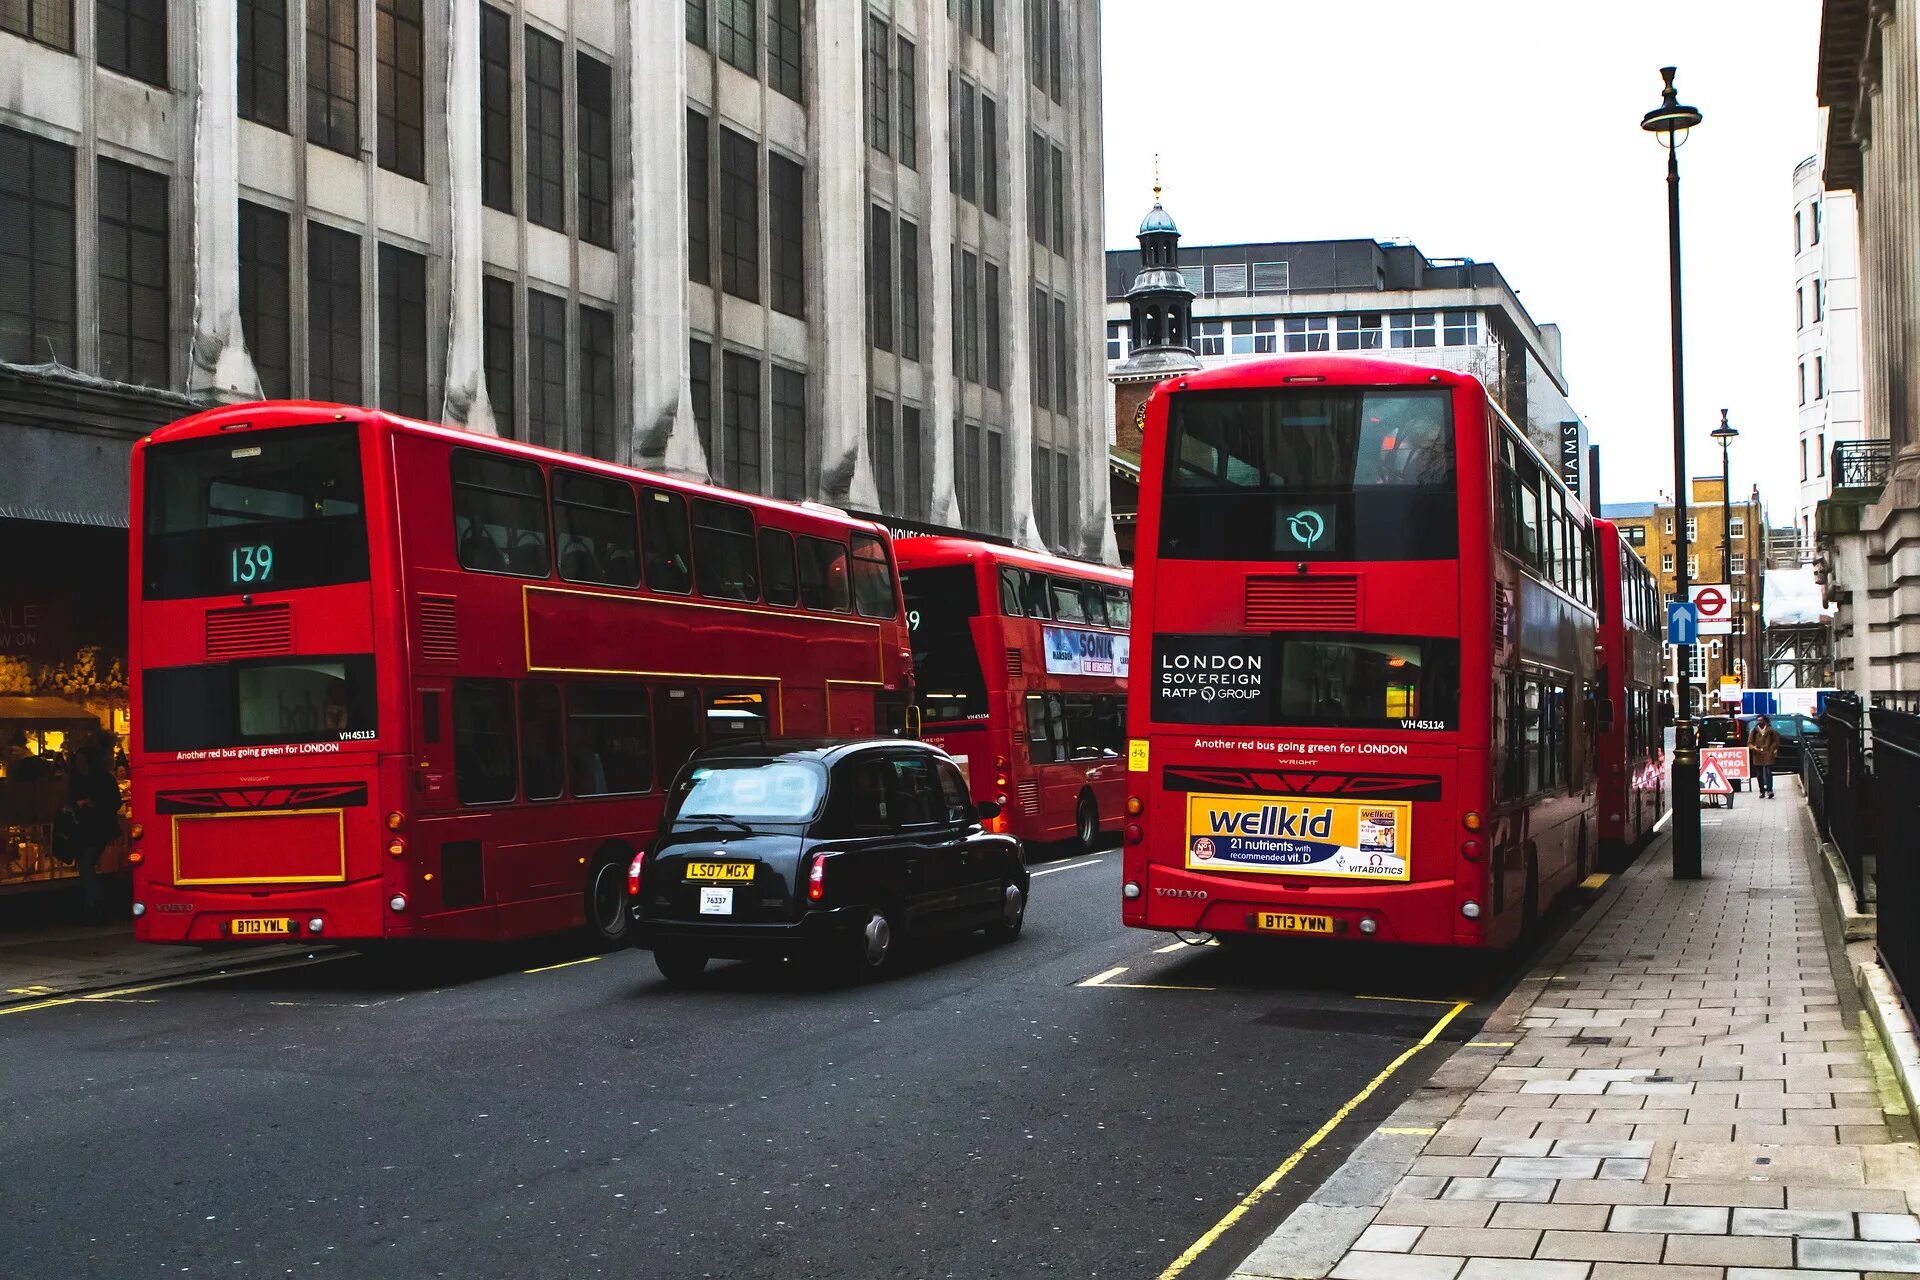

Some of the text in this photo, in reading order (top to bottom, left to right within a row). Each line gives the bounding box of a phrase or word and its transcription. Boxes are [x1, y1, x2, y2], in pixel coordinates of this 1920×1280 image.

[232, 544, 273, 582] 139
[1080, 634, 1114, 659] SONIC
[1162, 655, 1261, 669] LONDON
[1162, 673, 1261, 685] SOVEREIGN
[1162, 688, 1260, 699] RATP GROUP
[1401, 719, 1444, 730] VH45114
[339, 730, 376, 740] VH45113
[177, 743, 339, 760] Another red bus going green for LONDON
[1194, 739, 1408, 755] Another red bus going green for LONDON
[1209, 805, 1333, 838] wellkid
[1361, 811, 1393, 819] wellkid
[1230, 838, 1311, 853] 21 nutrients with
[1230, 852, 1311, 863] recommended vit. D
[691, 864, 750, 878] LS07 MGX
[1349, 865, 1403, 875] VITABIOTICS
[1154, 887, 1208, 900] VOLVO
[238, 920, 284, 932] BT13 YWL
[1266, 915, 1326, 930] BT13 YWN
